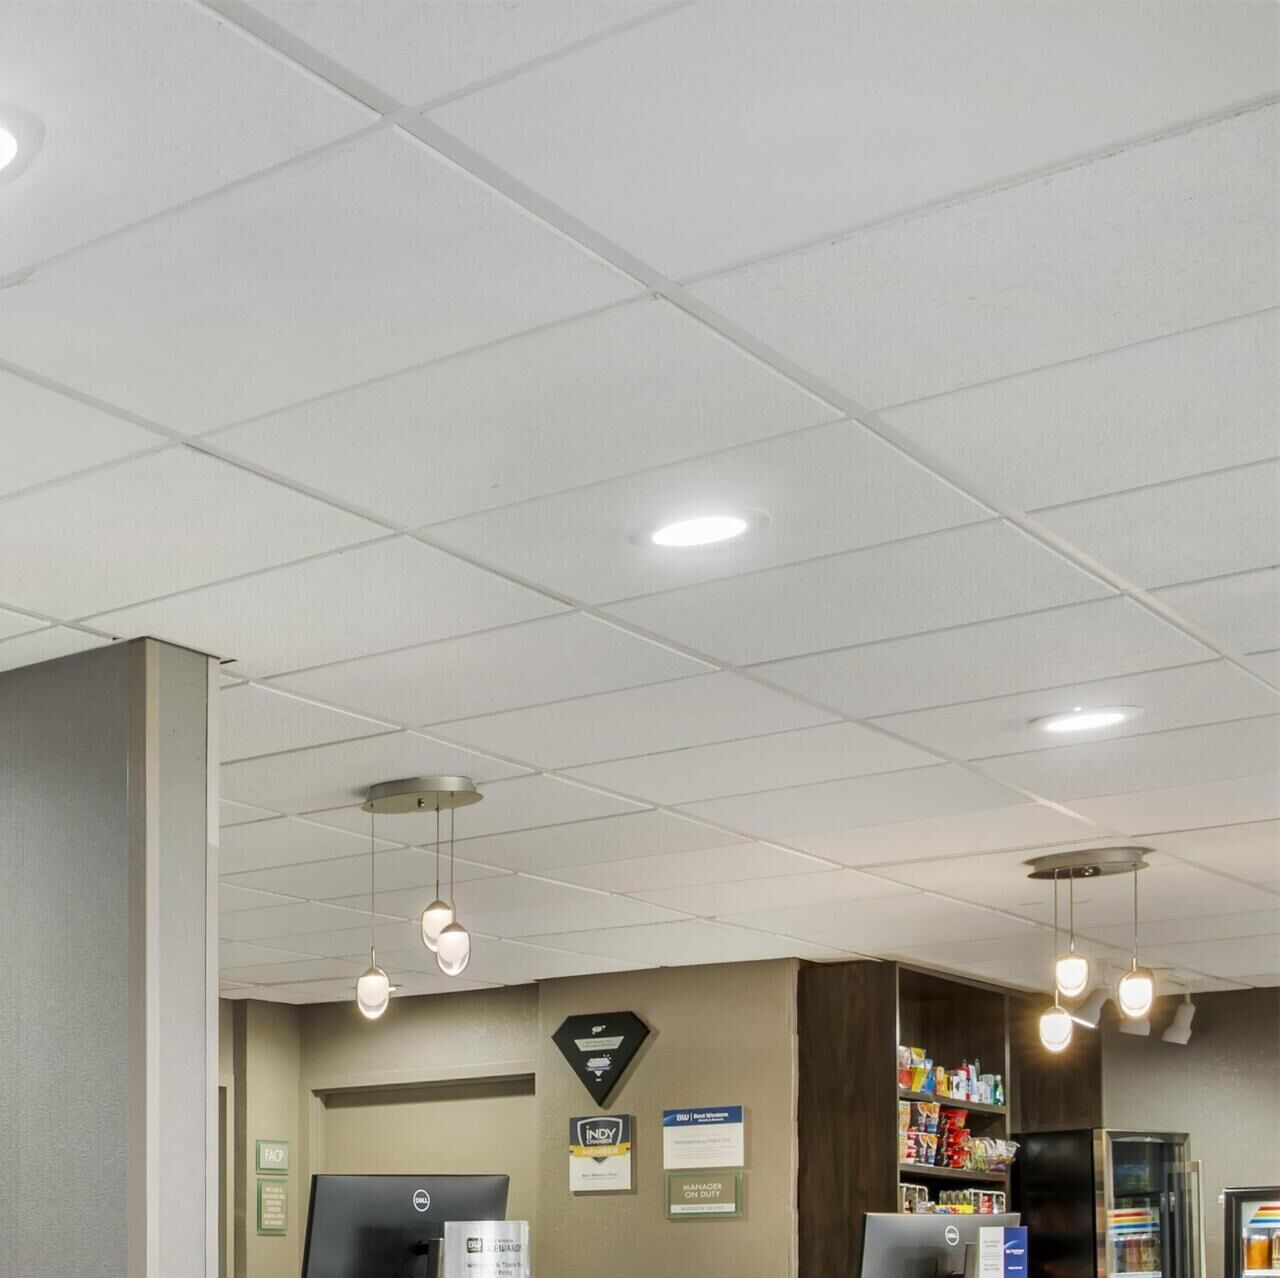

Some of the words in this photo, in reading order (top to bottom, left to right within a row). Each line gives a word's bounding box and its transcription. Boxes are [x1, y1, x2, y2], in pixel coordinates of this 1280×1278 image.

[682, 1182, 723, 1191] MANAGER
[684, 1190, 699, 1199] ON
[700, 1189, 721, 1198] DUTY
